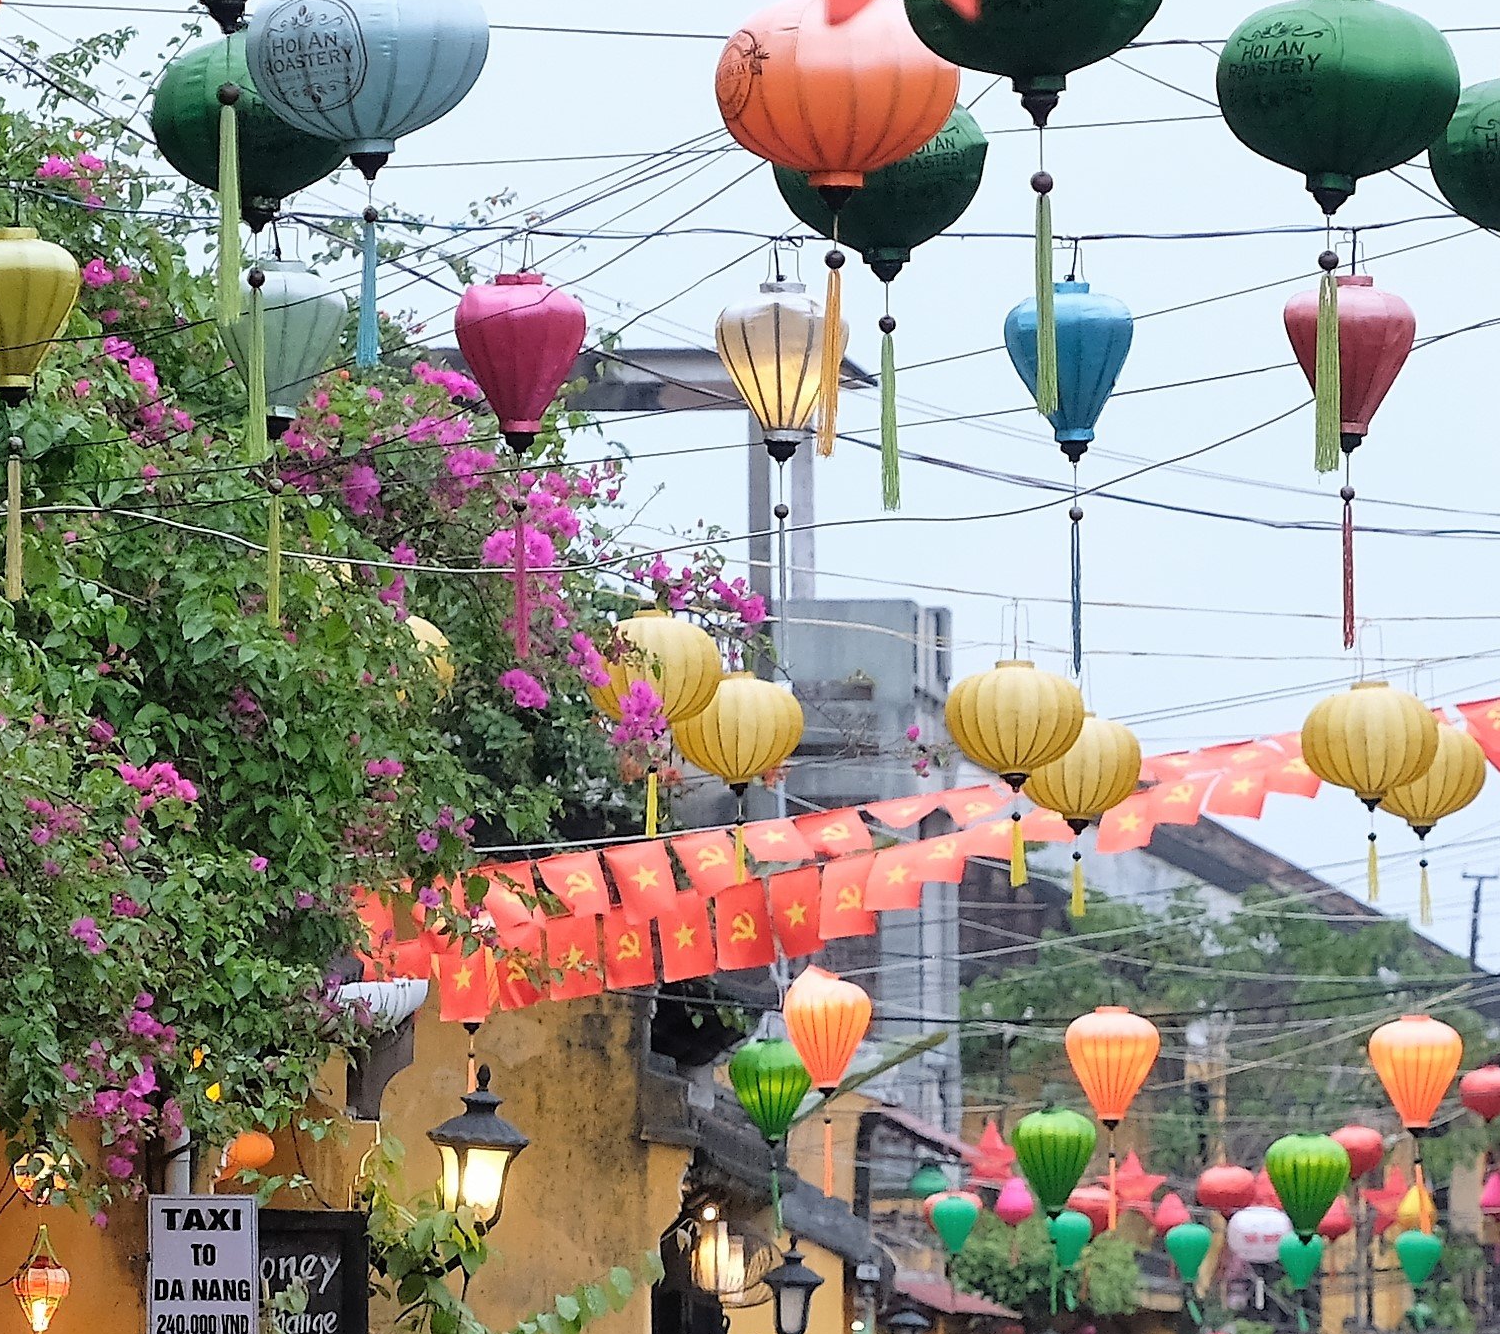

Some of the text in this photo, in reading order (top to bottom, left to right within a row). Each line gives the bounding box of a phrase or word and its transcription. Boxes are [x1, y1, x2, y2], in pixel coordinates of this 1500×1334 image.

[272, 31, 338, 56] HOI AN
[1273, 41, 1305, 58] AN
[161, 1208, 242, 1231] TAXI
[190, 1243, 217, 1266] TO
[260, 1252, 341, 1295] oney
[154, 1279, 250, 1302] DA NANG
